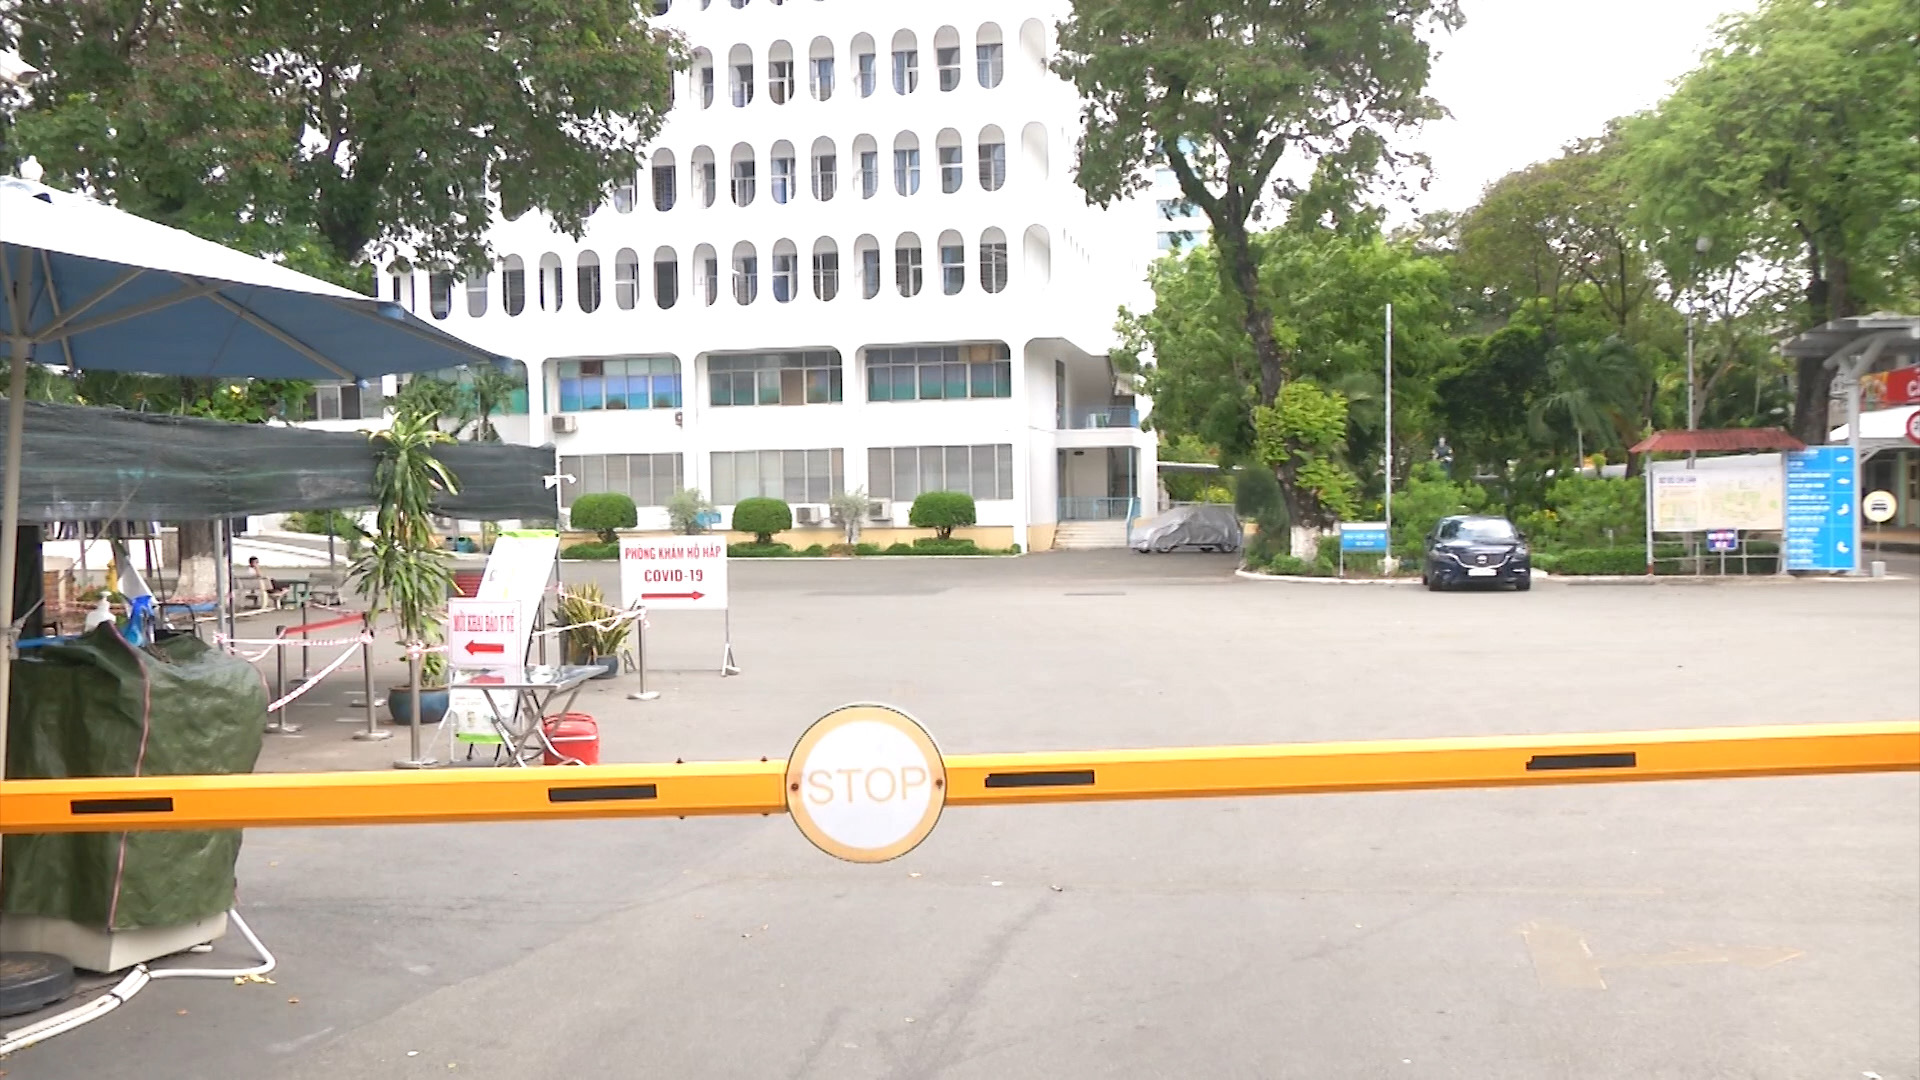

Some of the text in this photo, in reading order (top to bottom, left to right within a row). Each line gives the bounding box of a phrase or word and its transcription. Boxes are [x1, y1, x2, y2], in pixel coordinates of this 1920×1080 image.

[625, 543, 656, 560] PHÒNG
[658, 543, 684, 560] KHÁM
[644, 568, 704, 583] COVID-19
[807, 765, 927, 806] STOP
